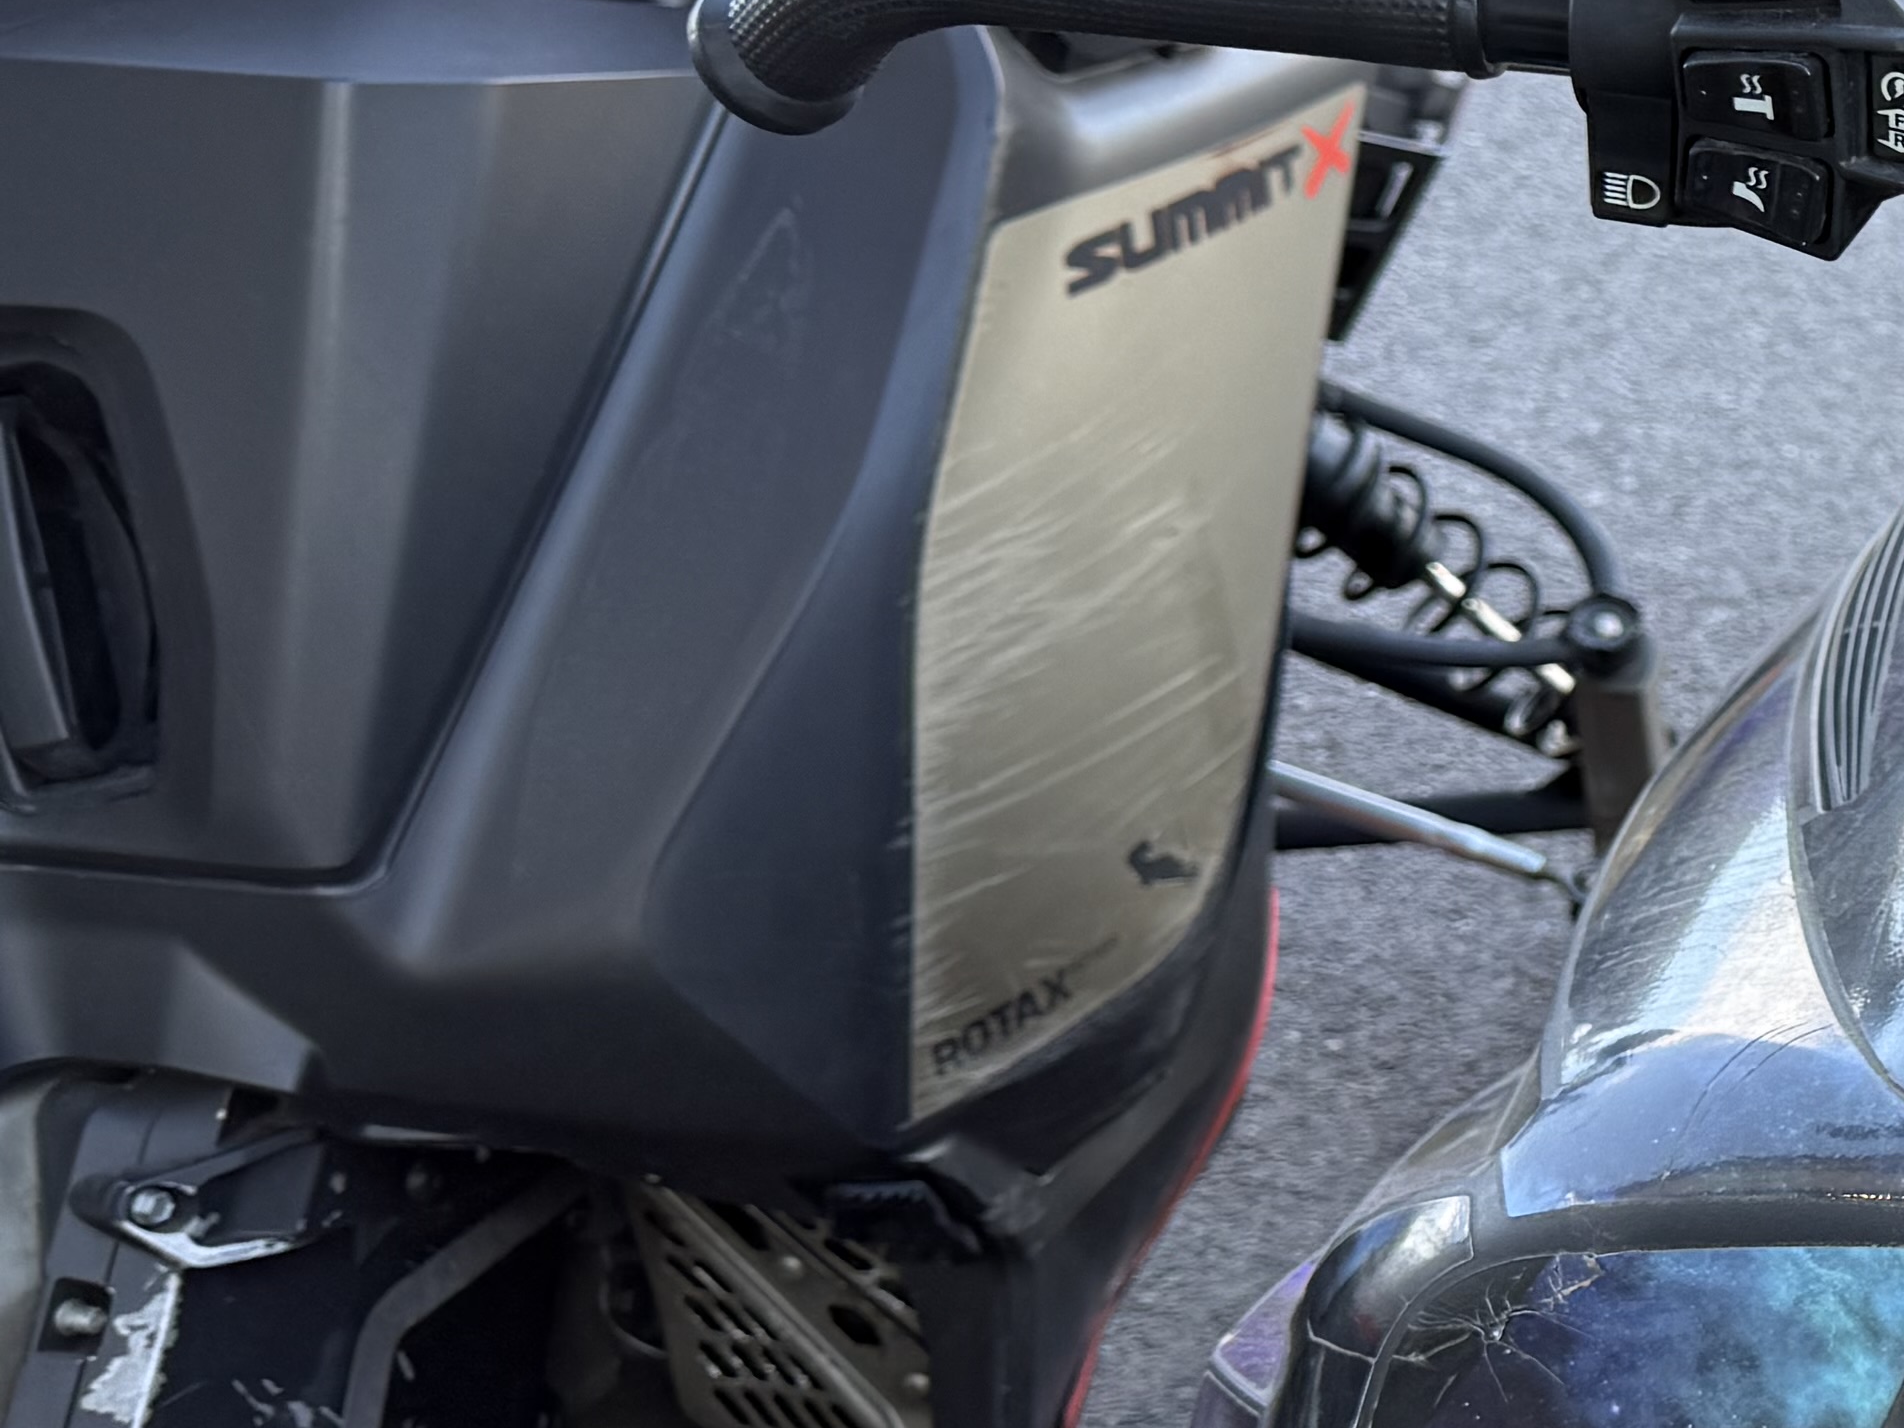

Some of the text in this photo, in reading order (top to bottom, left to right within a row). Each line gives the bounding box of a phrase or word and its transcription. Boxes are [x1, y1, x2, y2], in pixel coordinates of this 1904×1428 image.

[1065, 100, 1355, 297] SUMMIT X
[932, 969, 1073, 1075] ROTAX
